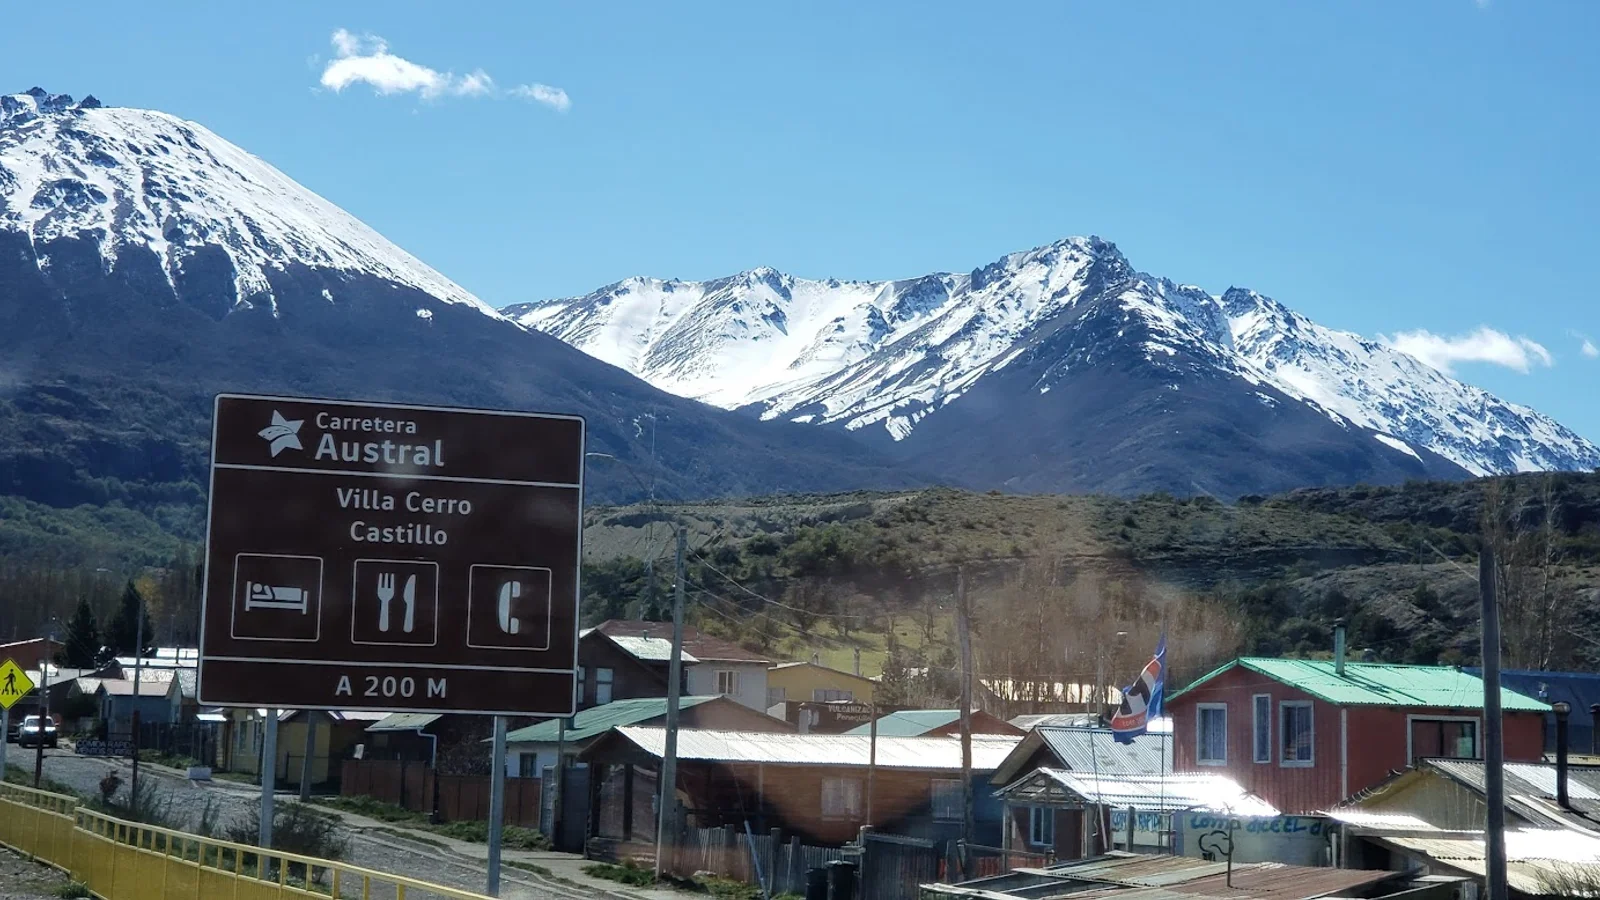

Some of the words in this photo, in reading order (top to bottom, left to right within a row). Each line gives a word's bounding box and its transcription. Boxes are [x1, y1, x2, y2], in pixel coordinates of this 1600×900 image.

[316, 412, 417, 434] Carretera
[315, 433, 444, 467] Austral
[336, 487, 394, 510] Villa
[406, 491, 472, 515] Cerro
[350, 520, 448, 546] Castillo
[335, 675, 352, 696] A
[364, 676, 415, 698] 200
[427, 678, 447, 698] M
